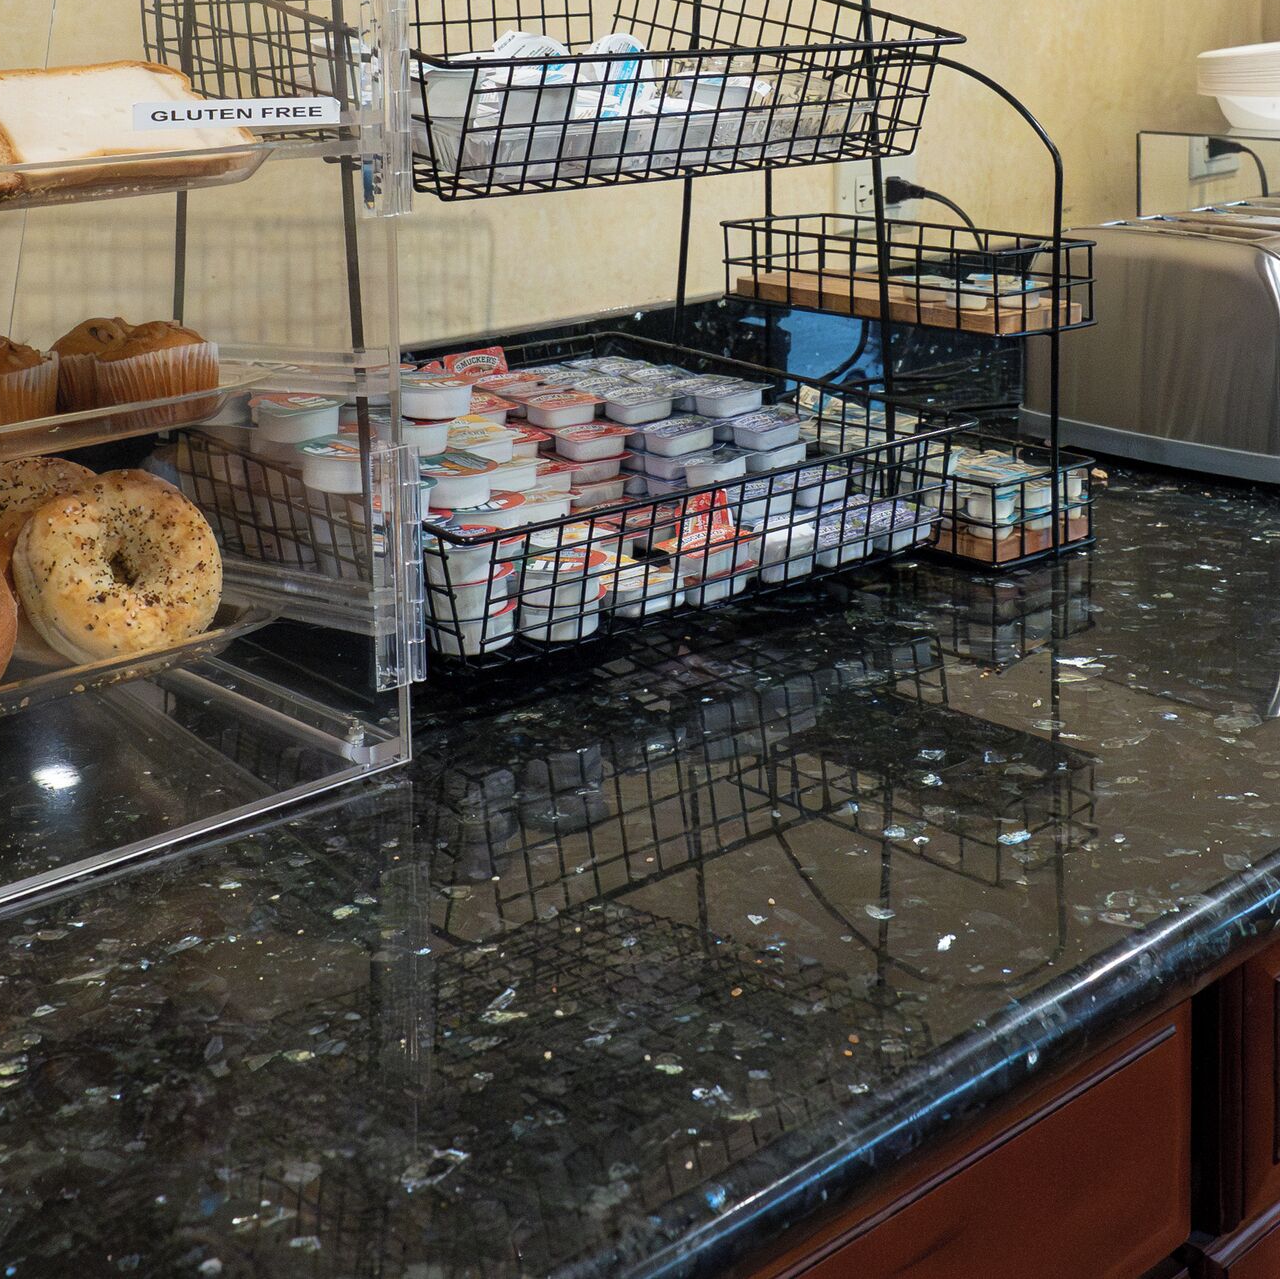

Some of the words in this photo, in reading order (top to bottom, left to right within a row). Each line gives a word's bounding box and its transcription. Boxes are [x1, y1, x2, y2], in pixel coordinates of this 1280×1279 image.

[150, 107, 253, 122] GLUTEN
[261, 106, 323, 119] FREE
[455, 355, 497, 372] SMUCKER'S
